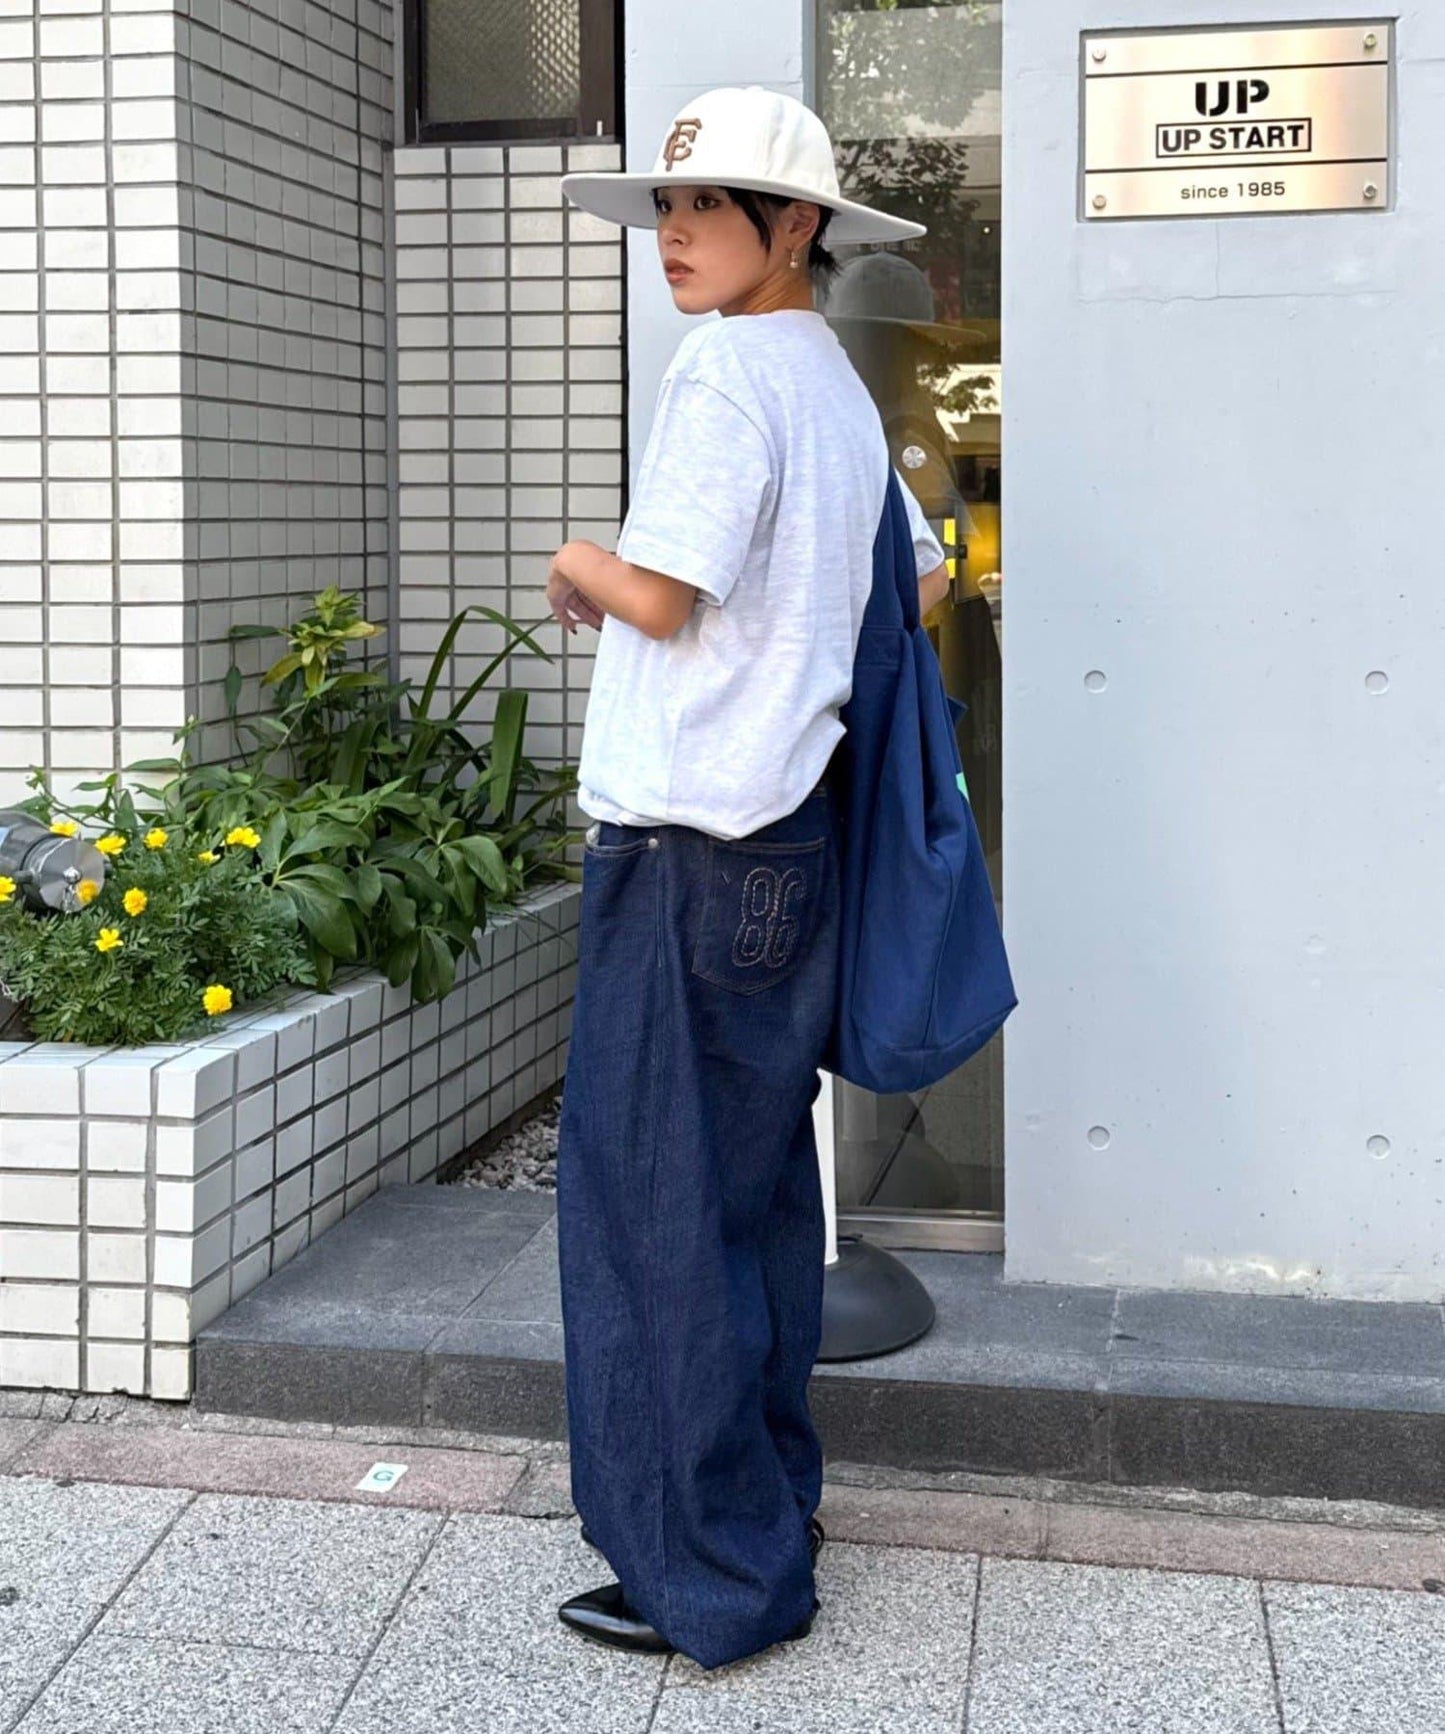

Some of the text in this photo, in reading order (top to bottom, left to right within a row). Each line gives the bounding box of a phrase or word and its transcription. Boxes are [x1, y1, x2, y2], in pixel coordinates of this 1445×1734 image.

[1195, 79, 1270, 116] UP
[1162, 125, 1305, 152] UP START
[1181, 181, 1286, 200] since 1985
[732, 867, 807, 968] 86
[373, 1470, 395, 1481] G
